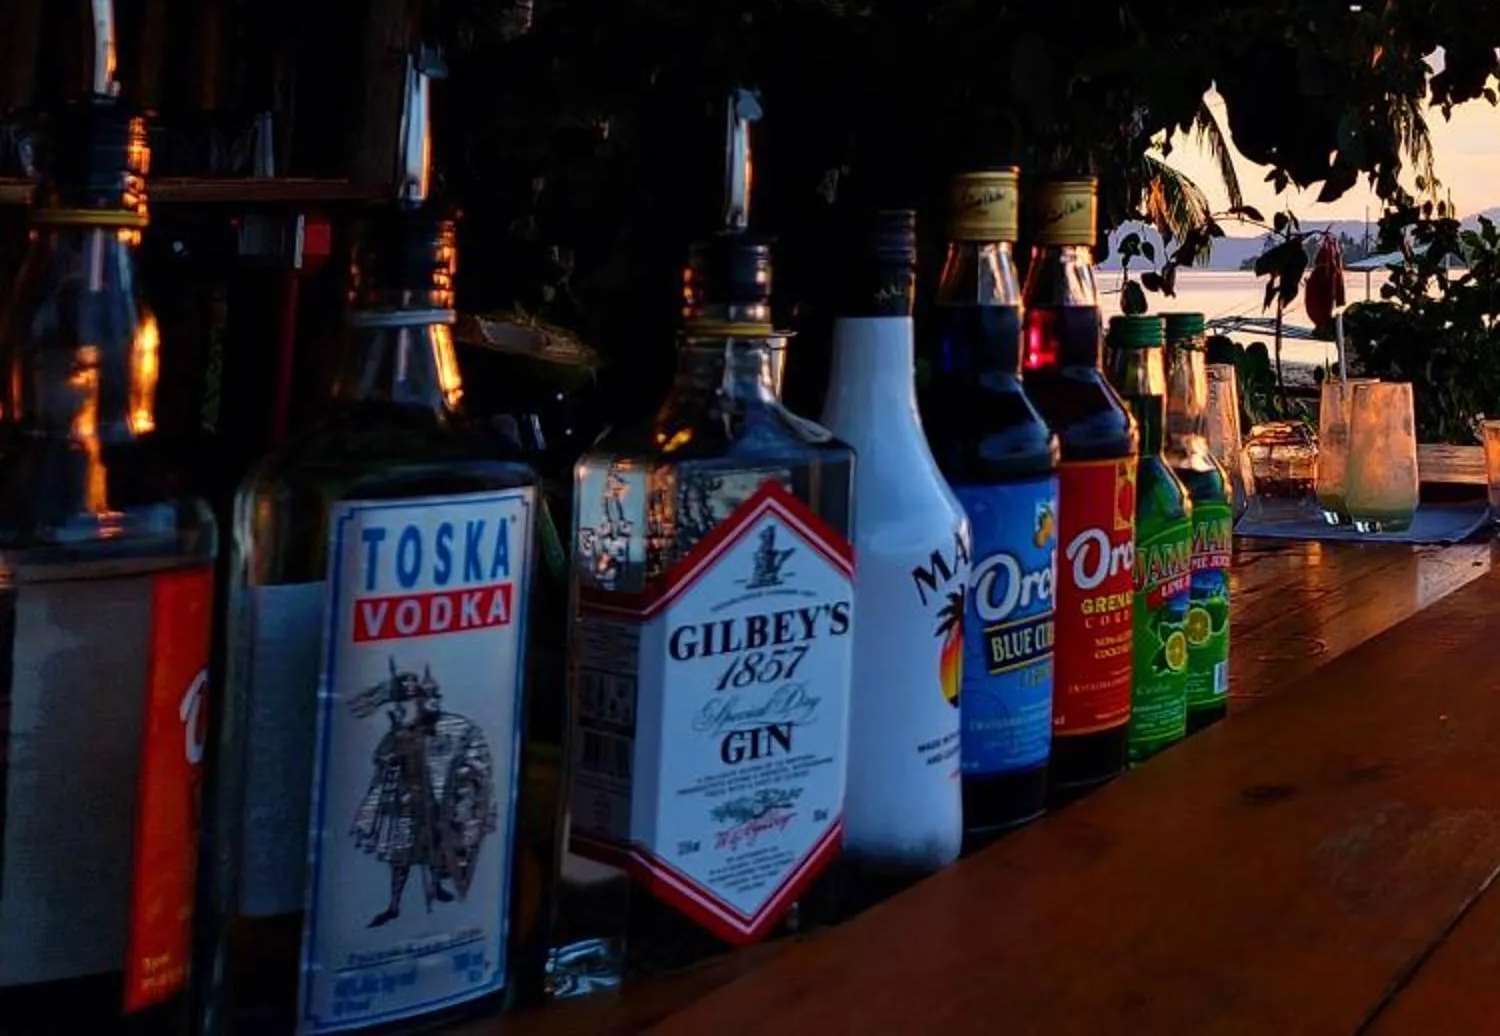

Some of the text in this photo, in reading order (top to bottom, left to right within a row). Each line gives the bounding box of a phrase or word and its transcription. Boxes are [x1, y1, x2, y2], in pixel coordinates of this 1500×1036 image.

[361, 518, 510, 590] TOSKA
[361, 587, 509, 638] VODKA
[669, 601, 850, 661] GILBEY'S
[716, 645, 808, 691] 1857
[991, 625, 1034, 663] BLUE
[721, 722, 793, 765] GIN
